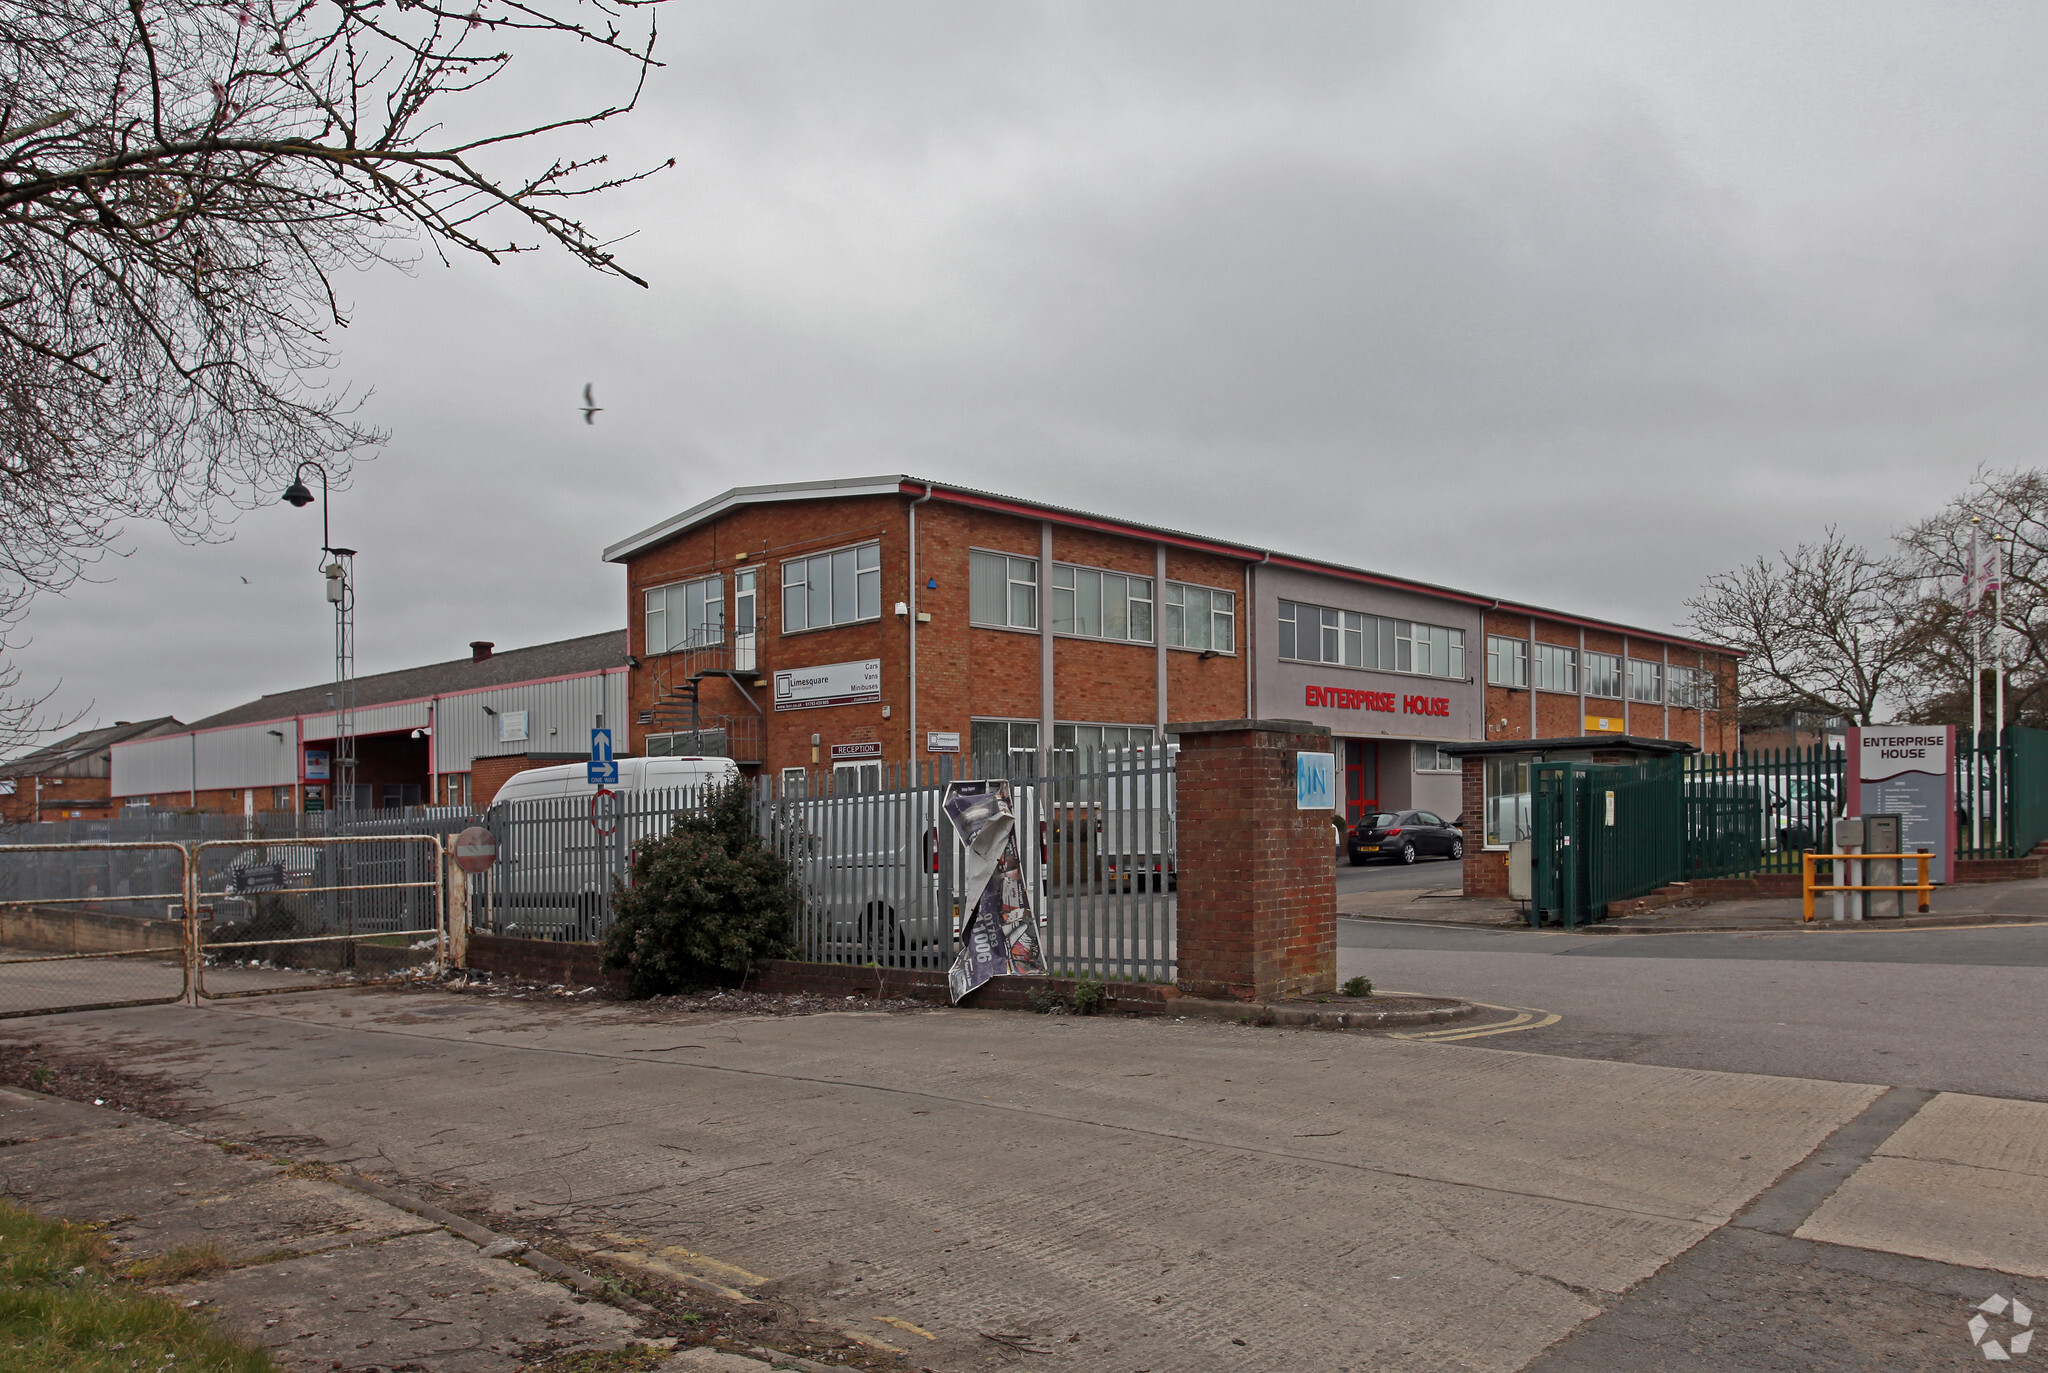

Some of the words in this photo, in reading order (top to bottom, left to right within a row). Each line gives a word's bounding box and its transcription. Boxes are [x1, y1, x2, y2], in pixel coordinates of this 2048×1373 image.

[791, 676, 829, 688] Limesquare
[850, 683, 878, 691] Minibuses
[1305, 685, 1396, 713] ENTERPRISE
[1403, 694, 1450, 717] HOUSE
[1863, 736, 1944, 747] ENTERPRISE
[838, 745, 874, 754] RECEPTION
[1881, 749, 1926, 759] HOUSE
[983, 912, 999, 948] 01793
